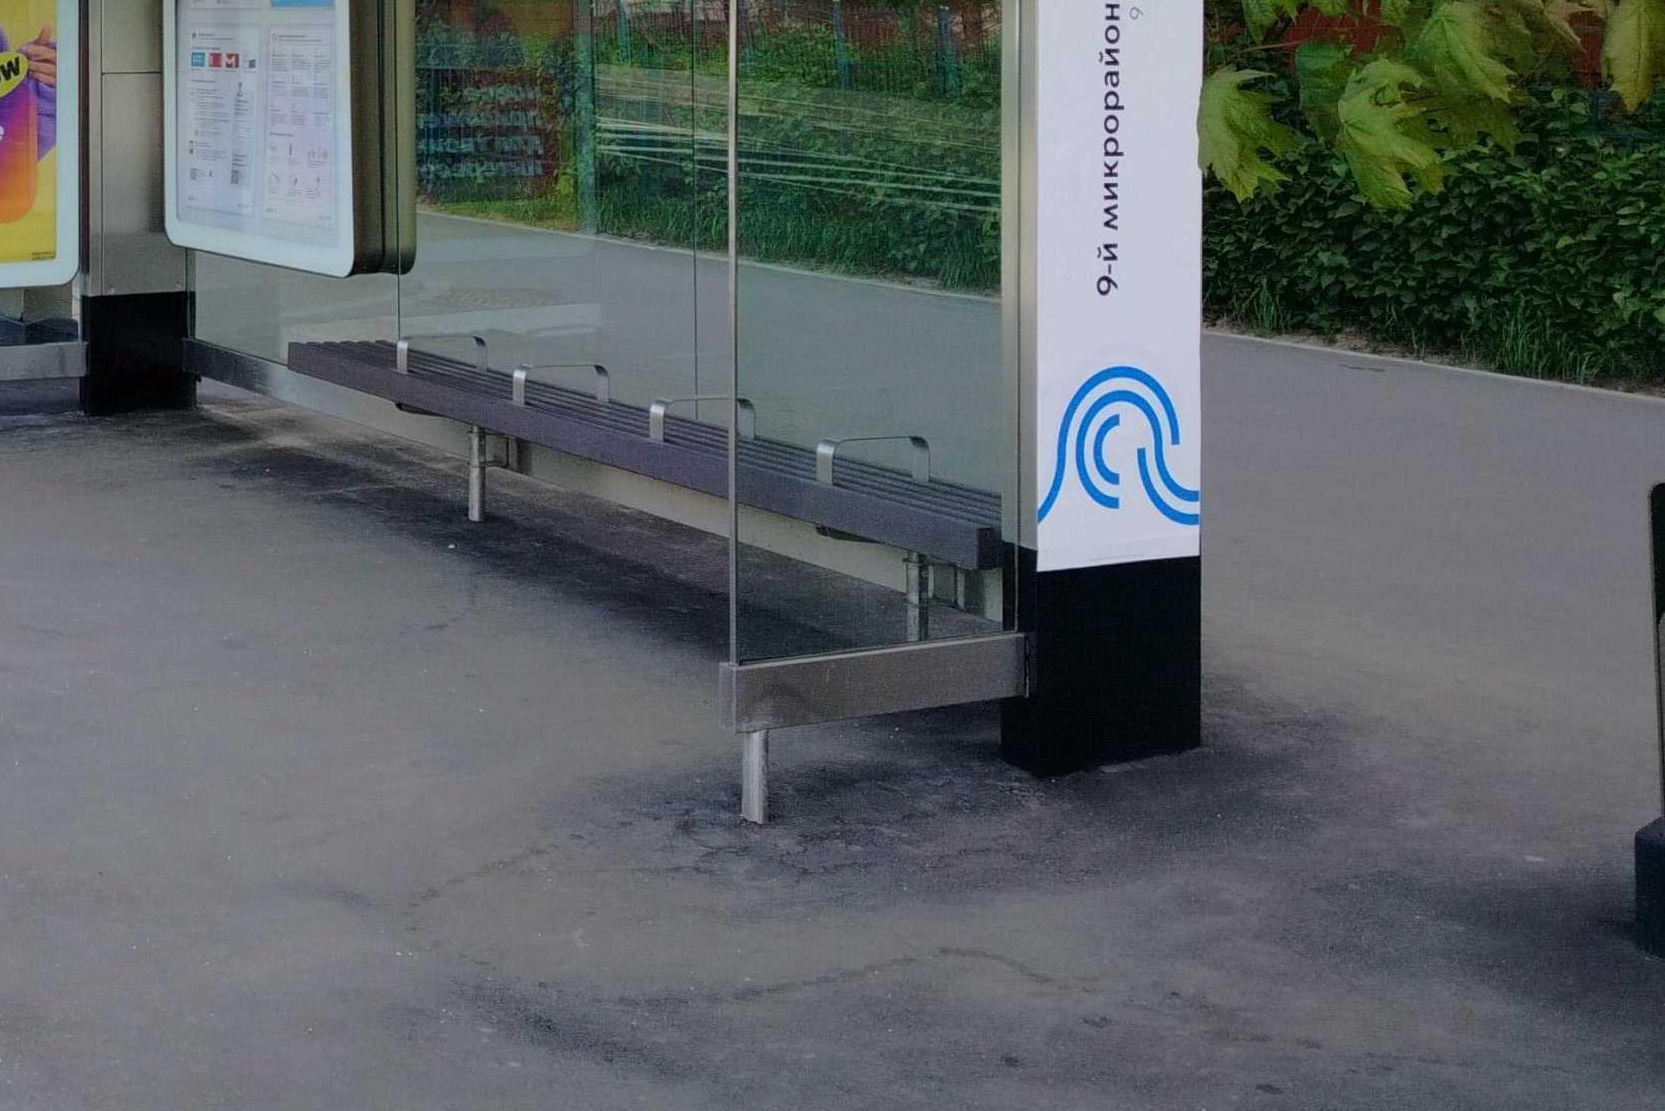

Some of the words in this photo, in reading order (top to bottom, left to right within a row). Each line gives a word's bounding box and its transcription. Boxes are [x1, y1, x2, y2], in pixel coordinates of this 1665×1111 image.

[1130, 6, 1144, 21] 9
[1099, 3, 1125, 231] микрорайон
[1096, 243, 1118, 296] 9-й
